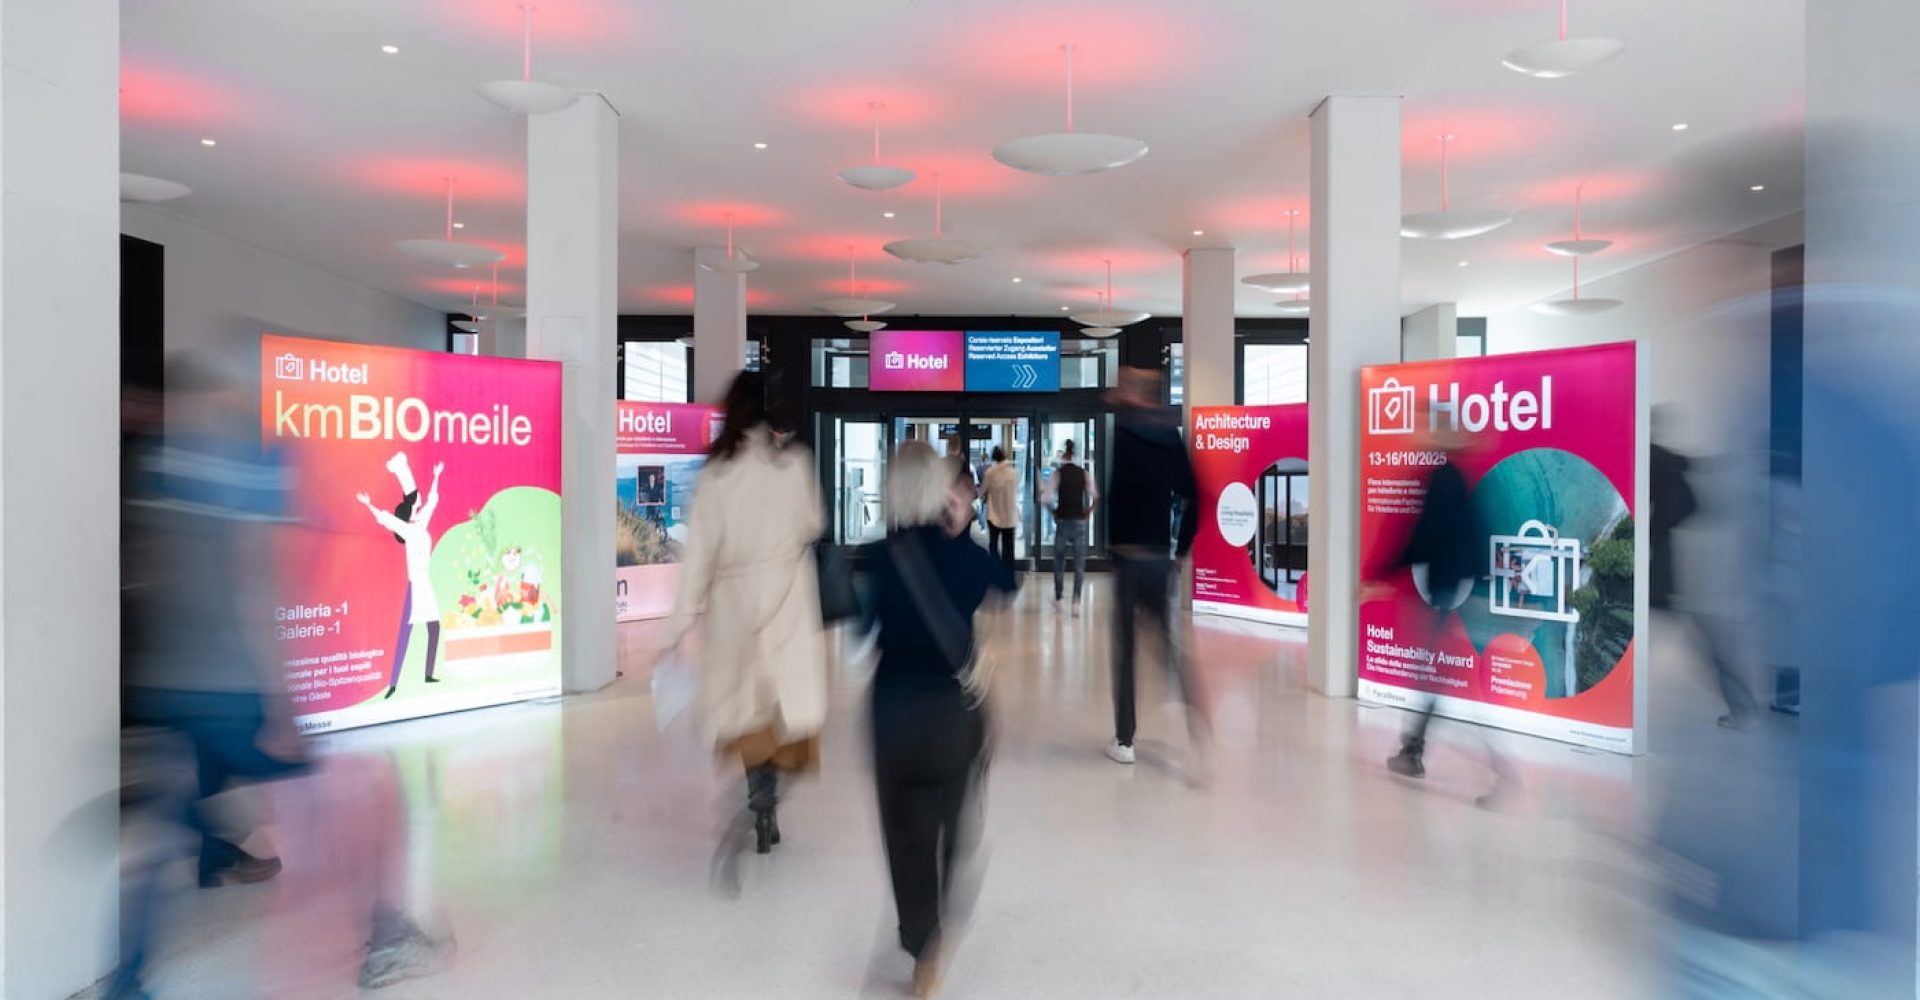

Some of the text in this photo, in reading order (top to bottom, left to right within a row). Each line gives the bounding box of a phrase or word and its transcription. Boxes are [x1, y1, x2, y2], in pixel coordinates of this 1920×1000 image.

[310, 359, 368, 385] Hotel
[907, 354, 948, 370] Hotel
[1428, 375, 1552, 433] Hotel
[619, 408, 671, 433] Hotel
[1196, 413, 1271, 430] Architecture
[1196, 434, 1249, 454] & Design
[1368, 451, 1447, 467] 13-16/10/2025
[275, 600, 348, 621] Galleria -1
[276, 620, 341, 640] Galerie -1
[1366, 624, 1393, 640] Hotel
[1366, 640, 1435, 664] Sustainability
[1437, 650, 1474, 669] Award
